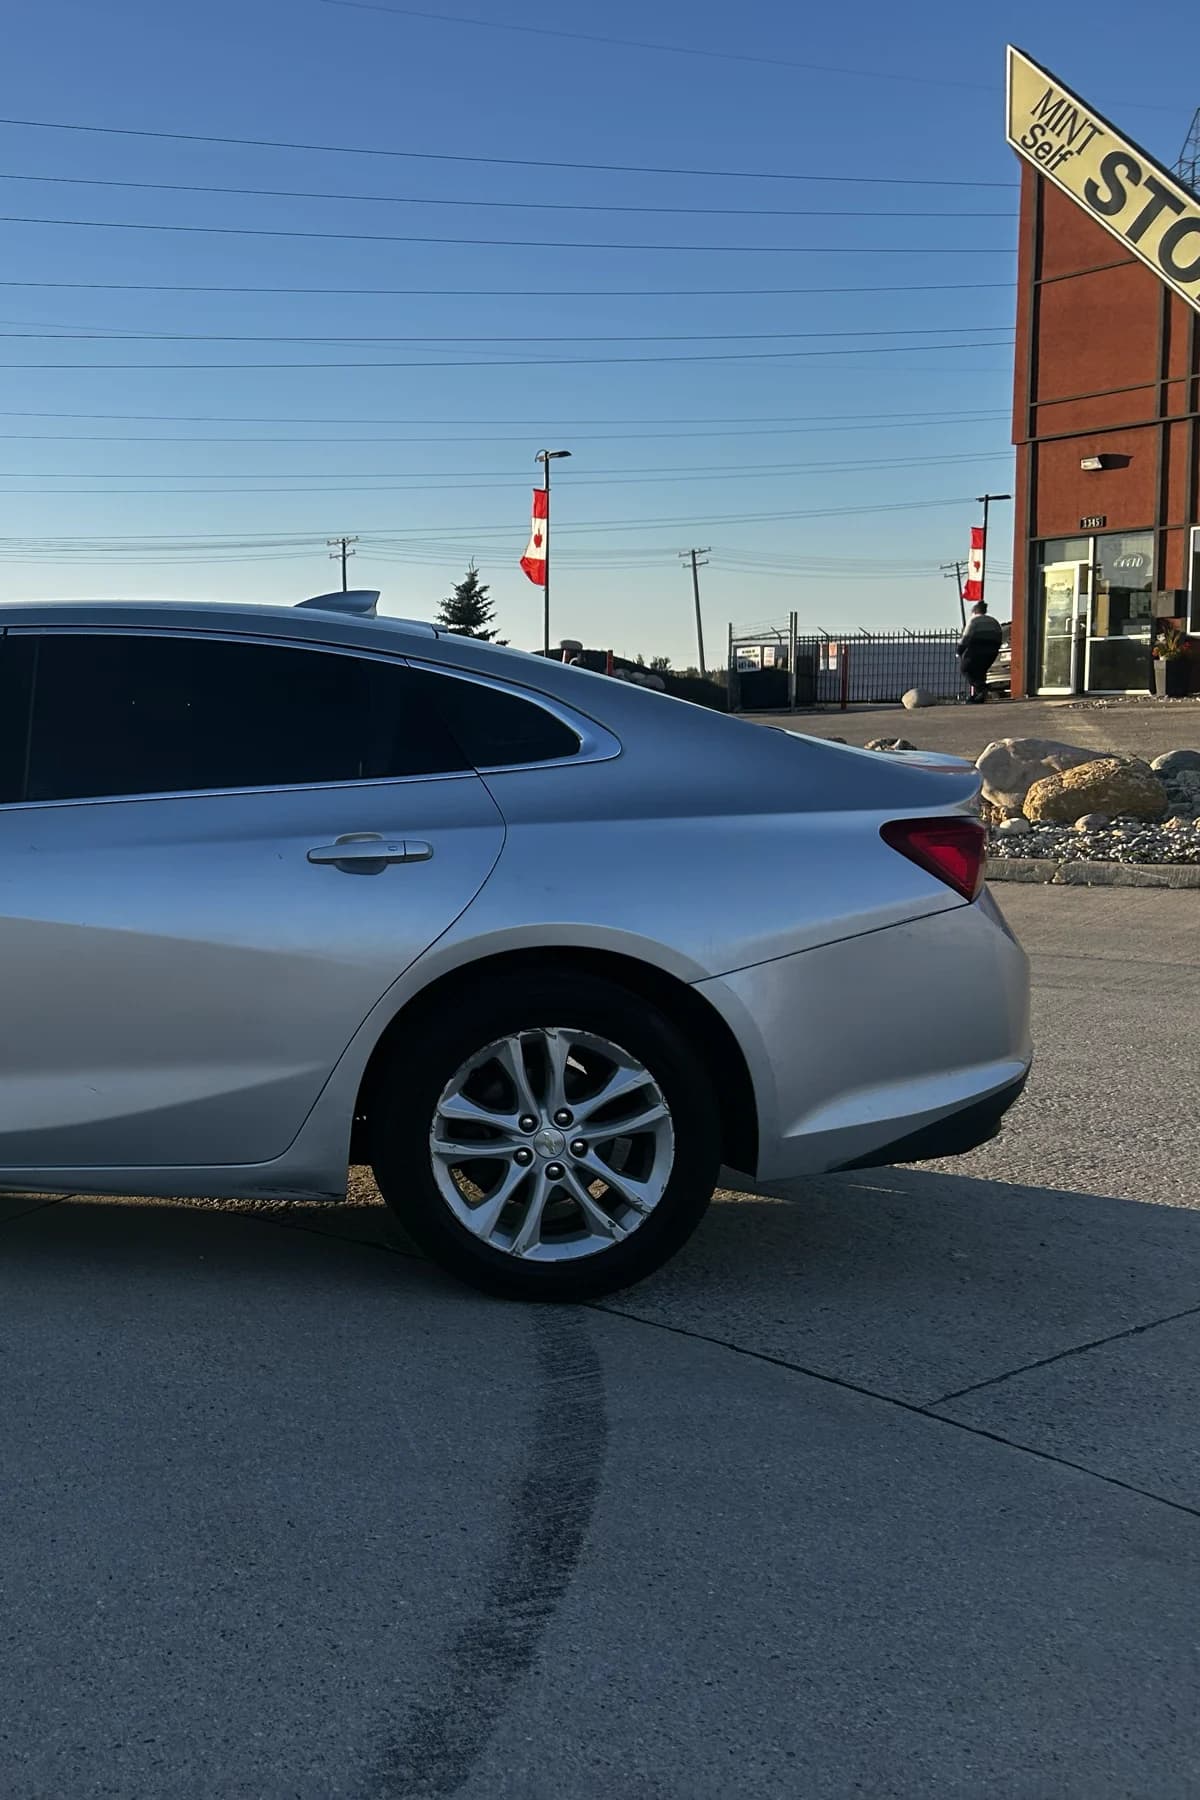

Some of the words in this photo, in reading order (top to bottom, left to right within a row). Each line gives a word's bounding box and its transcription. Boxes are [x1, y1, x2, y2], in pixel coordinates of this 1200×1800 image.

[1020, 123, 1073, 171] Self
[1030, 88, 1105, 156] MINT
[1084, 150, 1200, 302] STO
